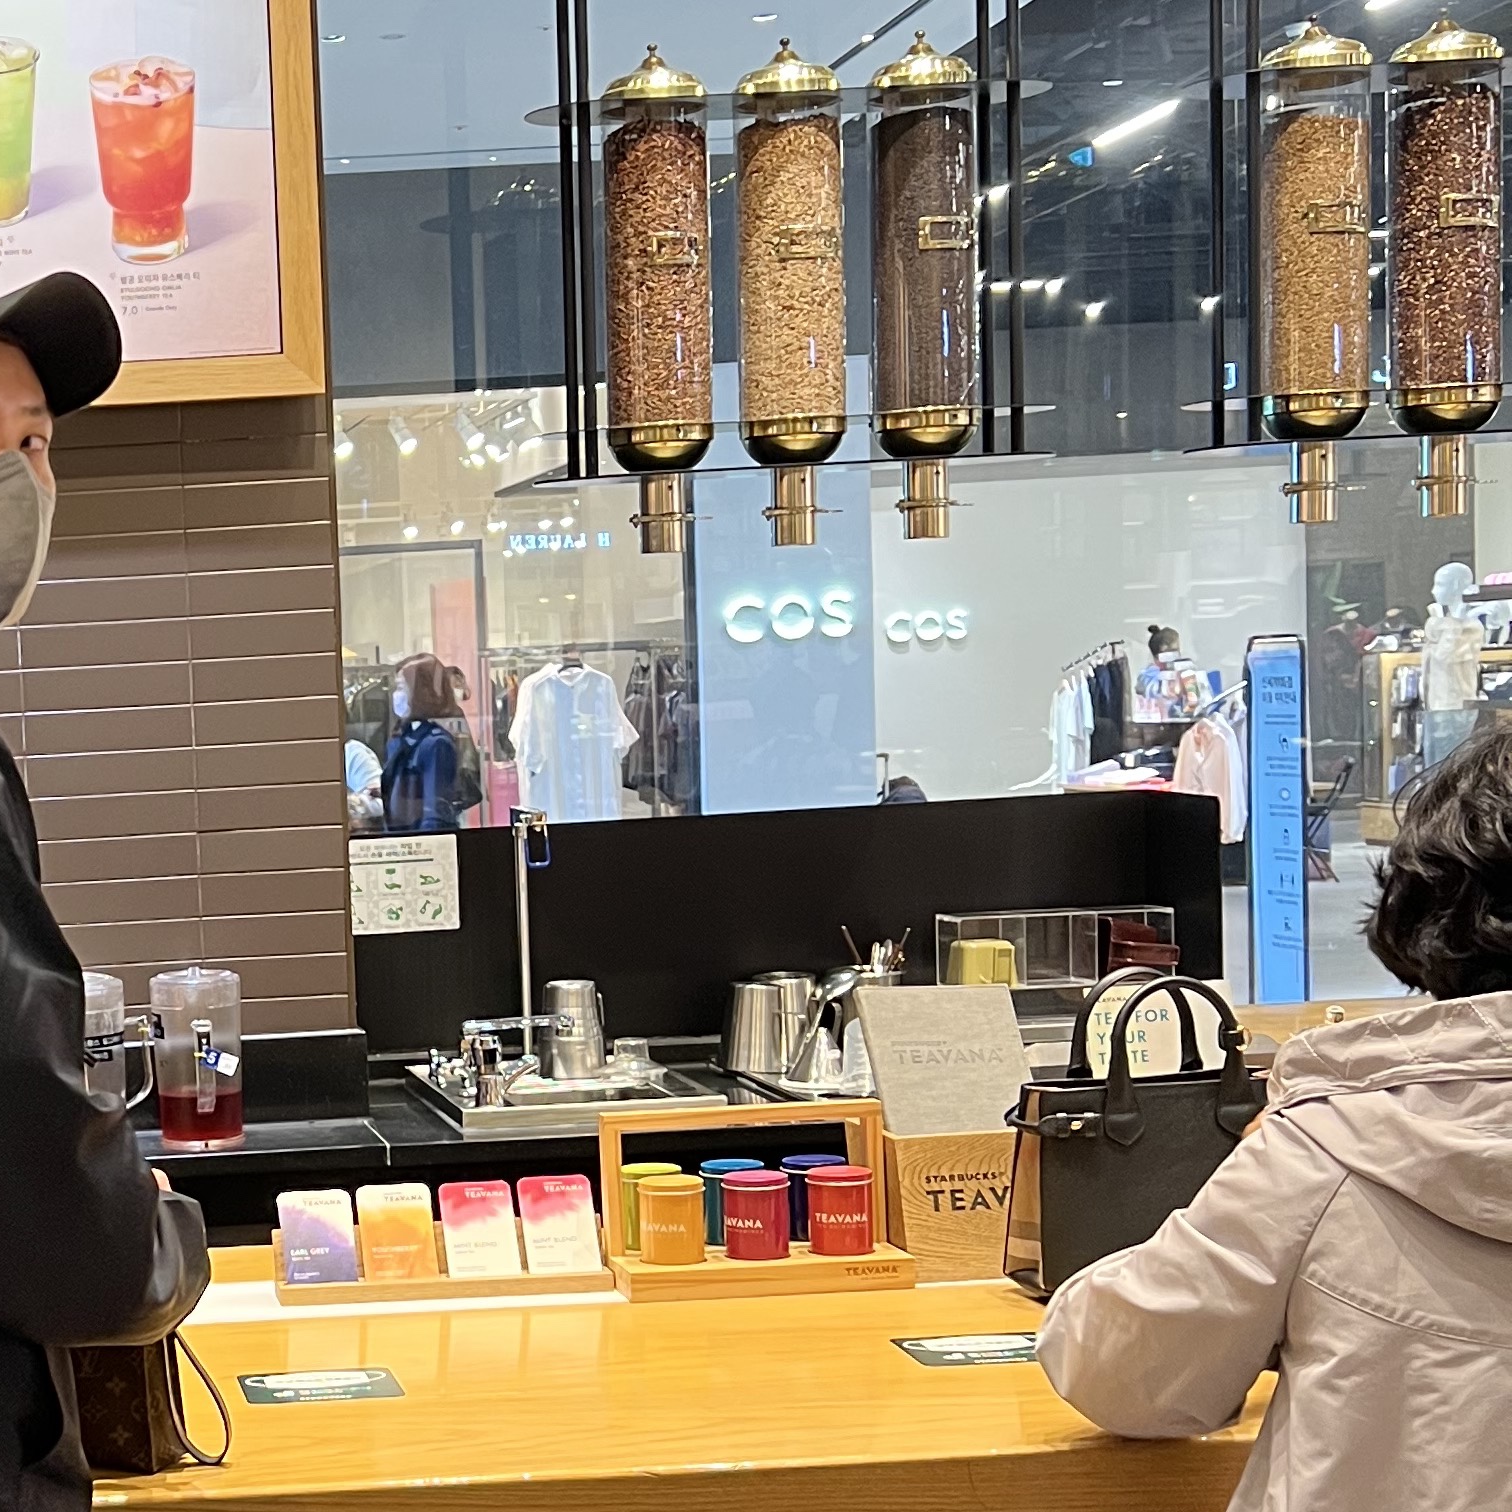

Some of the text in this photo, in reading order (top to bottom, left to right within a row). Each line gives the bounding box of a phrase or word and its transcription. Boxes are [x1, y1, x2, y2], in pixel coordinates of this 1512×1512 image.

[723, 589, 854, 643] COS
[886, 608, 968, 643] COS
[1135, 1008, 1170, 1023] FOR
[1096, 1030, 1147, 1045] YUR
[892, 1048, 1003, 1065] TEAVANA
[1098, 1049, 1149, 1065] TTE
[925, 1171, 998, 1184] STARBUCKS
[815, 1212, 868, 1223] TEAVANA
[290, 1247, 330, 1257] EARL GREY
[845, 1265, 899, 1276] TEAVANA
